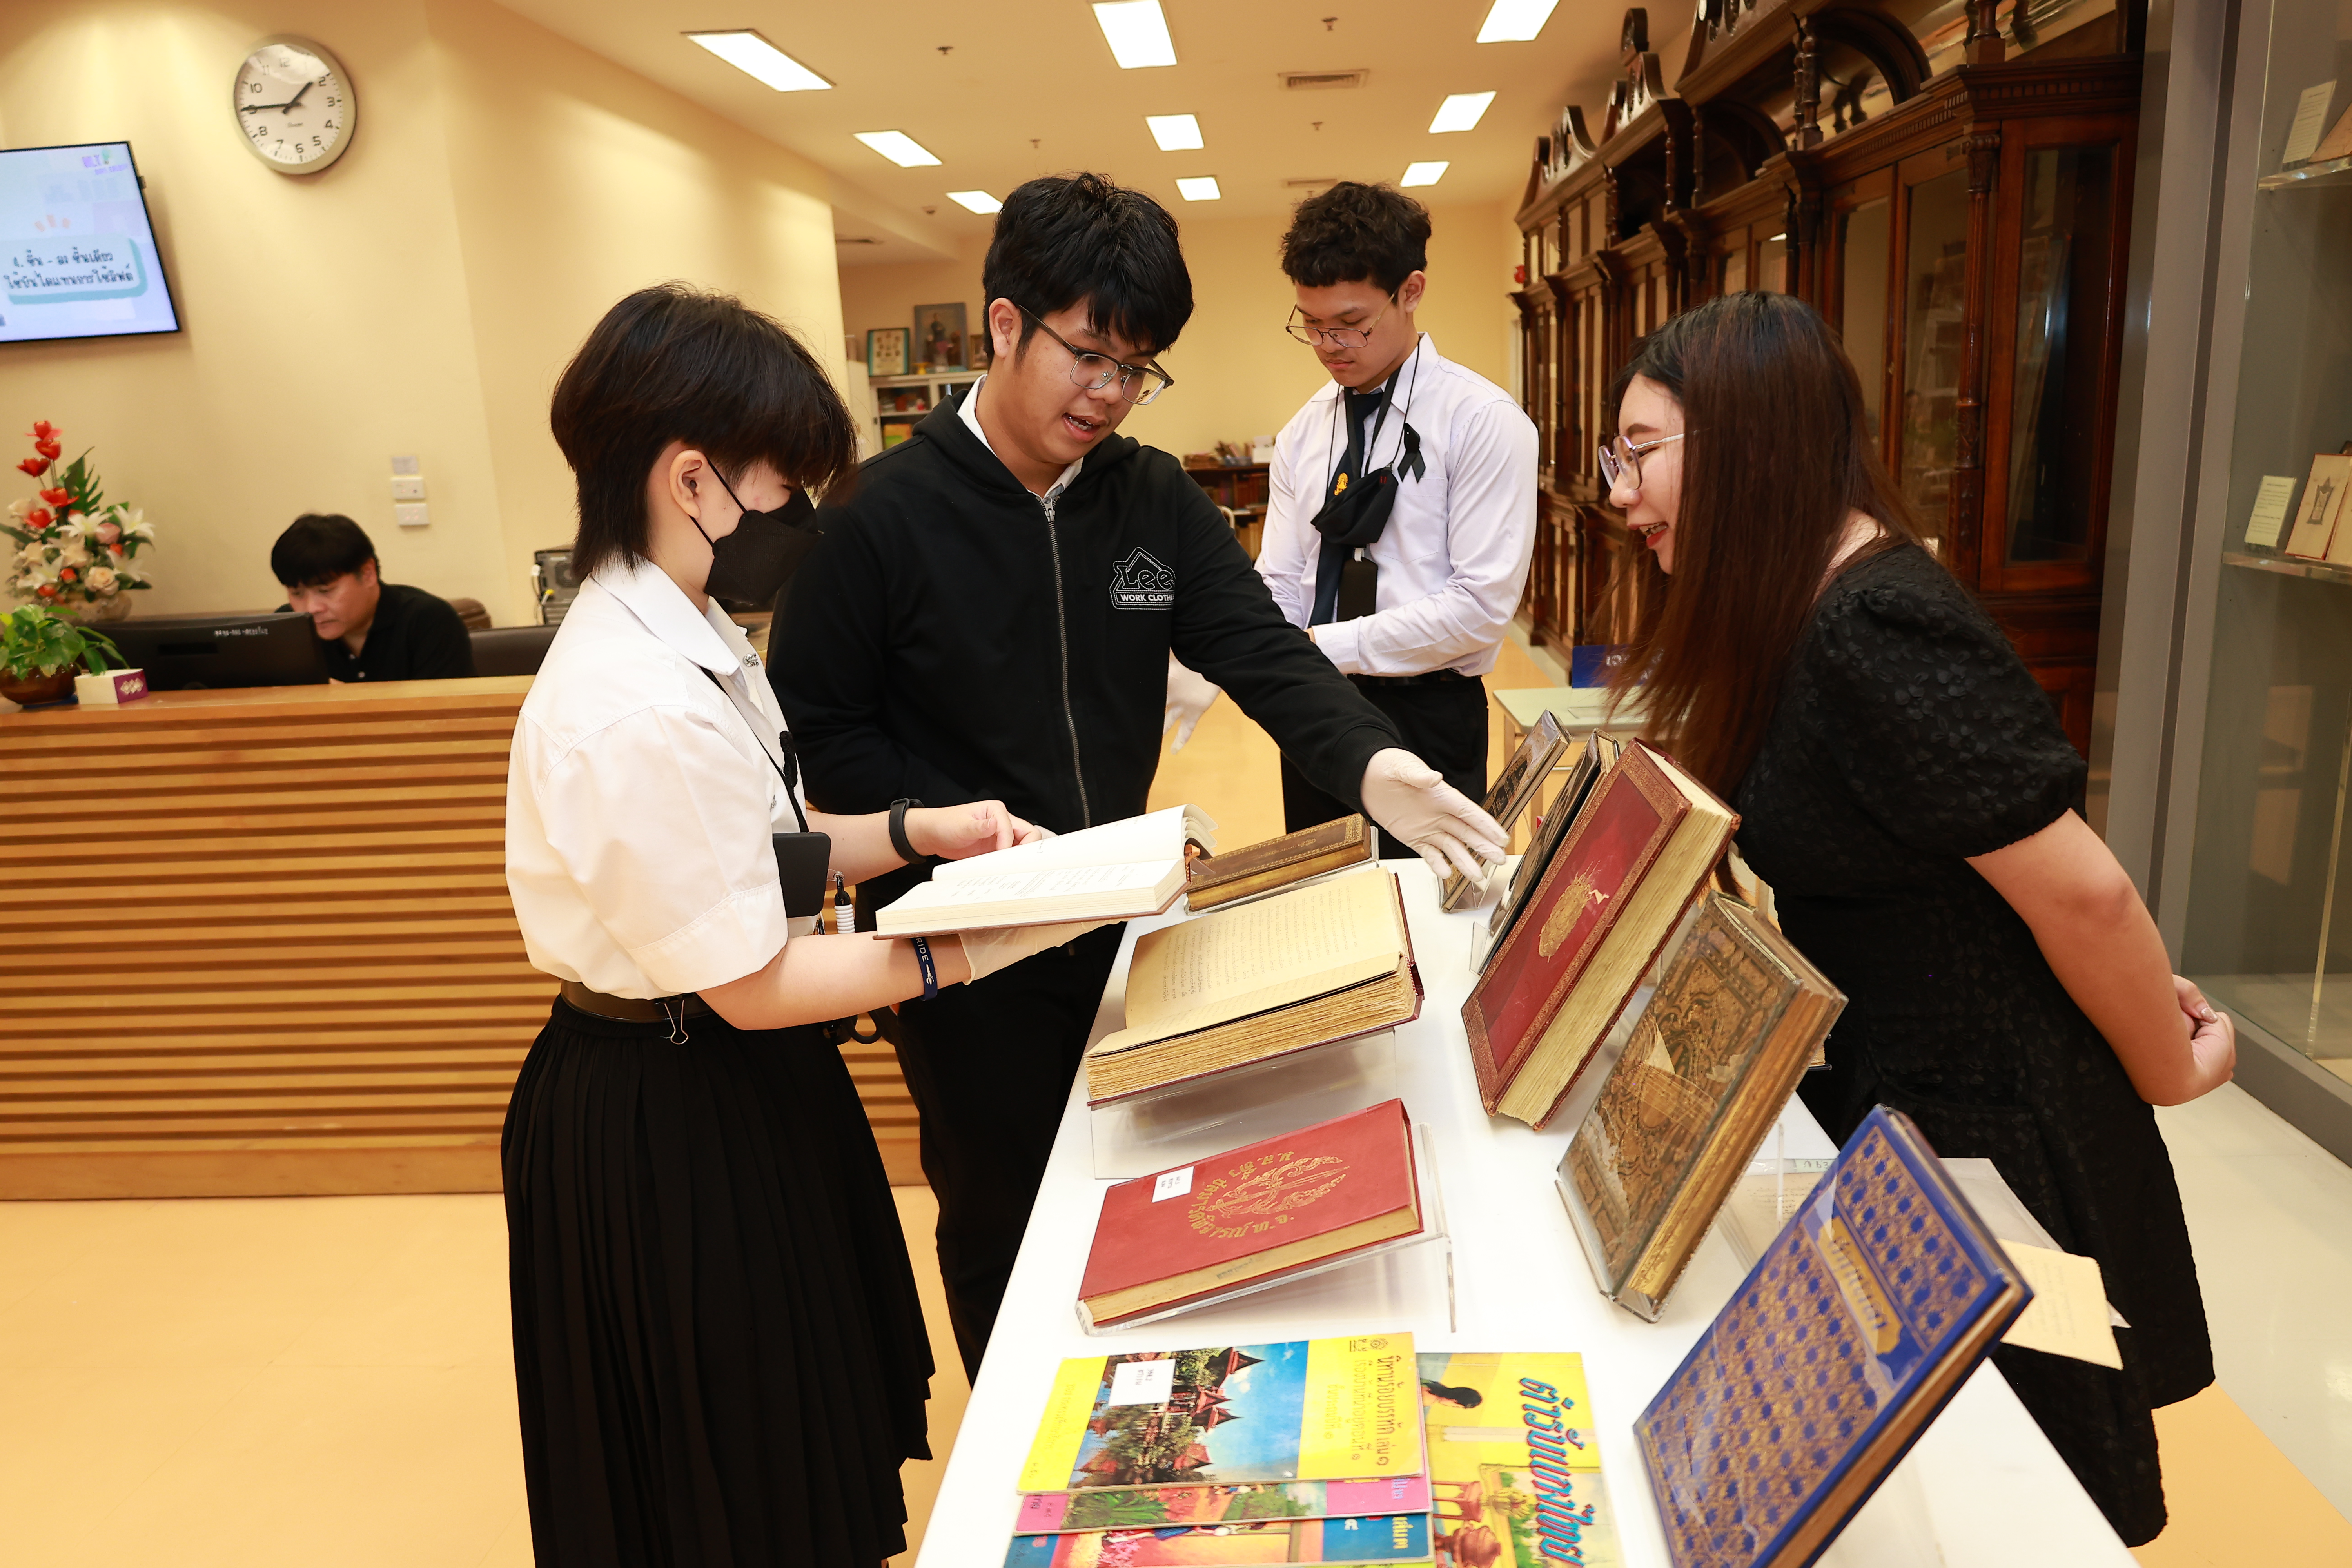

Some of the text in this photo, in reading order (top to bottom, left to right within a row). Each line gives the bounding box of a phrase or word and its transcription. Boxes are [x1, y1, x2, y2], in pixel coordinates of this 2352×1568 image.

[318, 76, 327, 87] 2
[250, 83, 262, 93] 10
[327, 96, 335, 107] 3
[325, 119, 334, 129] 4
[259, 126, 268, 136] 8
[276, 139, 284, 149] 7
[312, 136, 321, 146] 5
[295, 143, 304, 154] 6
[1116, 565, 1173, 590] Lee
[1376, 1355, 1405, 1466] นิทานร้อยบรรทัด เล่ม ๑
